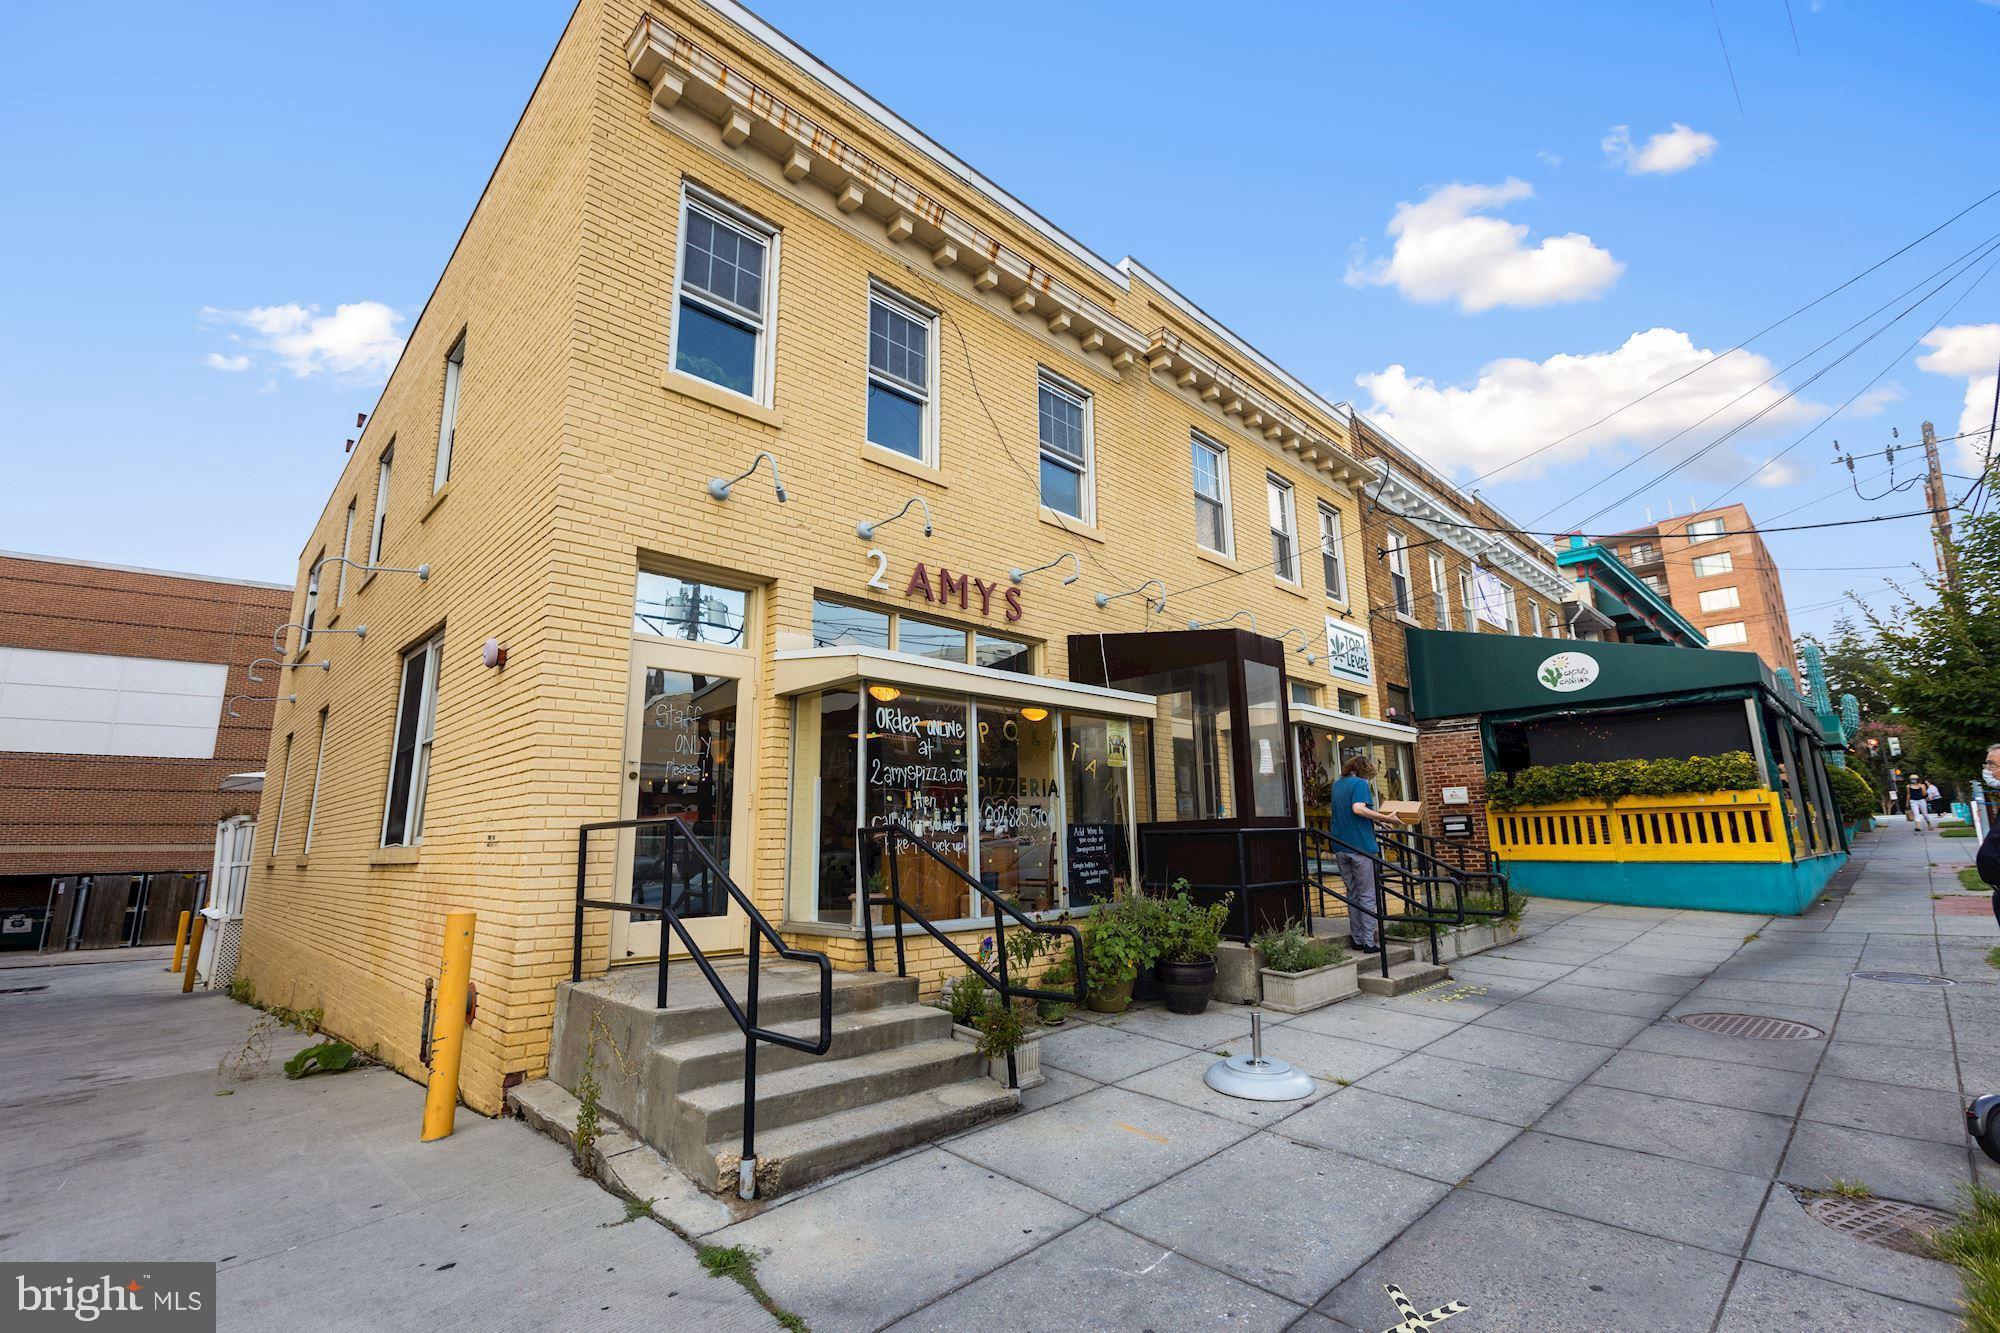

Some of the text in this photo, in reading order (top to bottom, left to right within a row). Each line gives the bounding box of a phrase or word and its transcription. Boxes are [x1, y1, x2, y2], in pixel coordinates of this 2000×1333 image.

[866, 549, 1023, 622] 2 AMYS
[1344, 635, 1361, 653] TOP
[1347, 653, 1369, 672] LEVEL
[656, 704, 703, 733] Staff
[675, 734, 712, 758] ONLY
[918, 738, 934, 760] at
[870, 758, 968, 788] 2amyspizza.com
[979, 776, 1060, 797] PIZZERIA
[913, 790, 936, 810] then
[952, 834, 967, 859] up!
